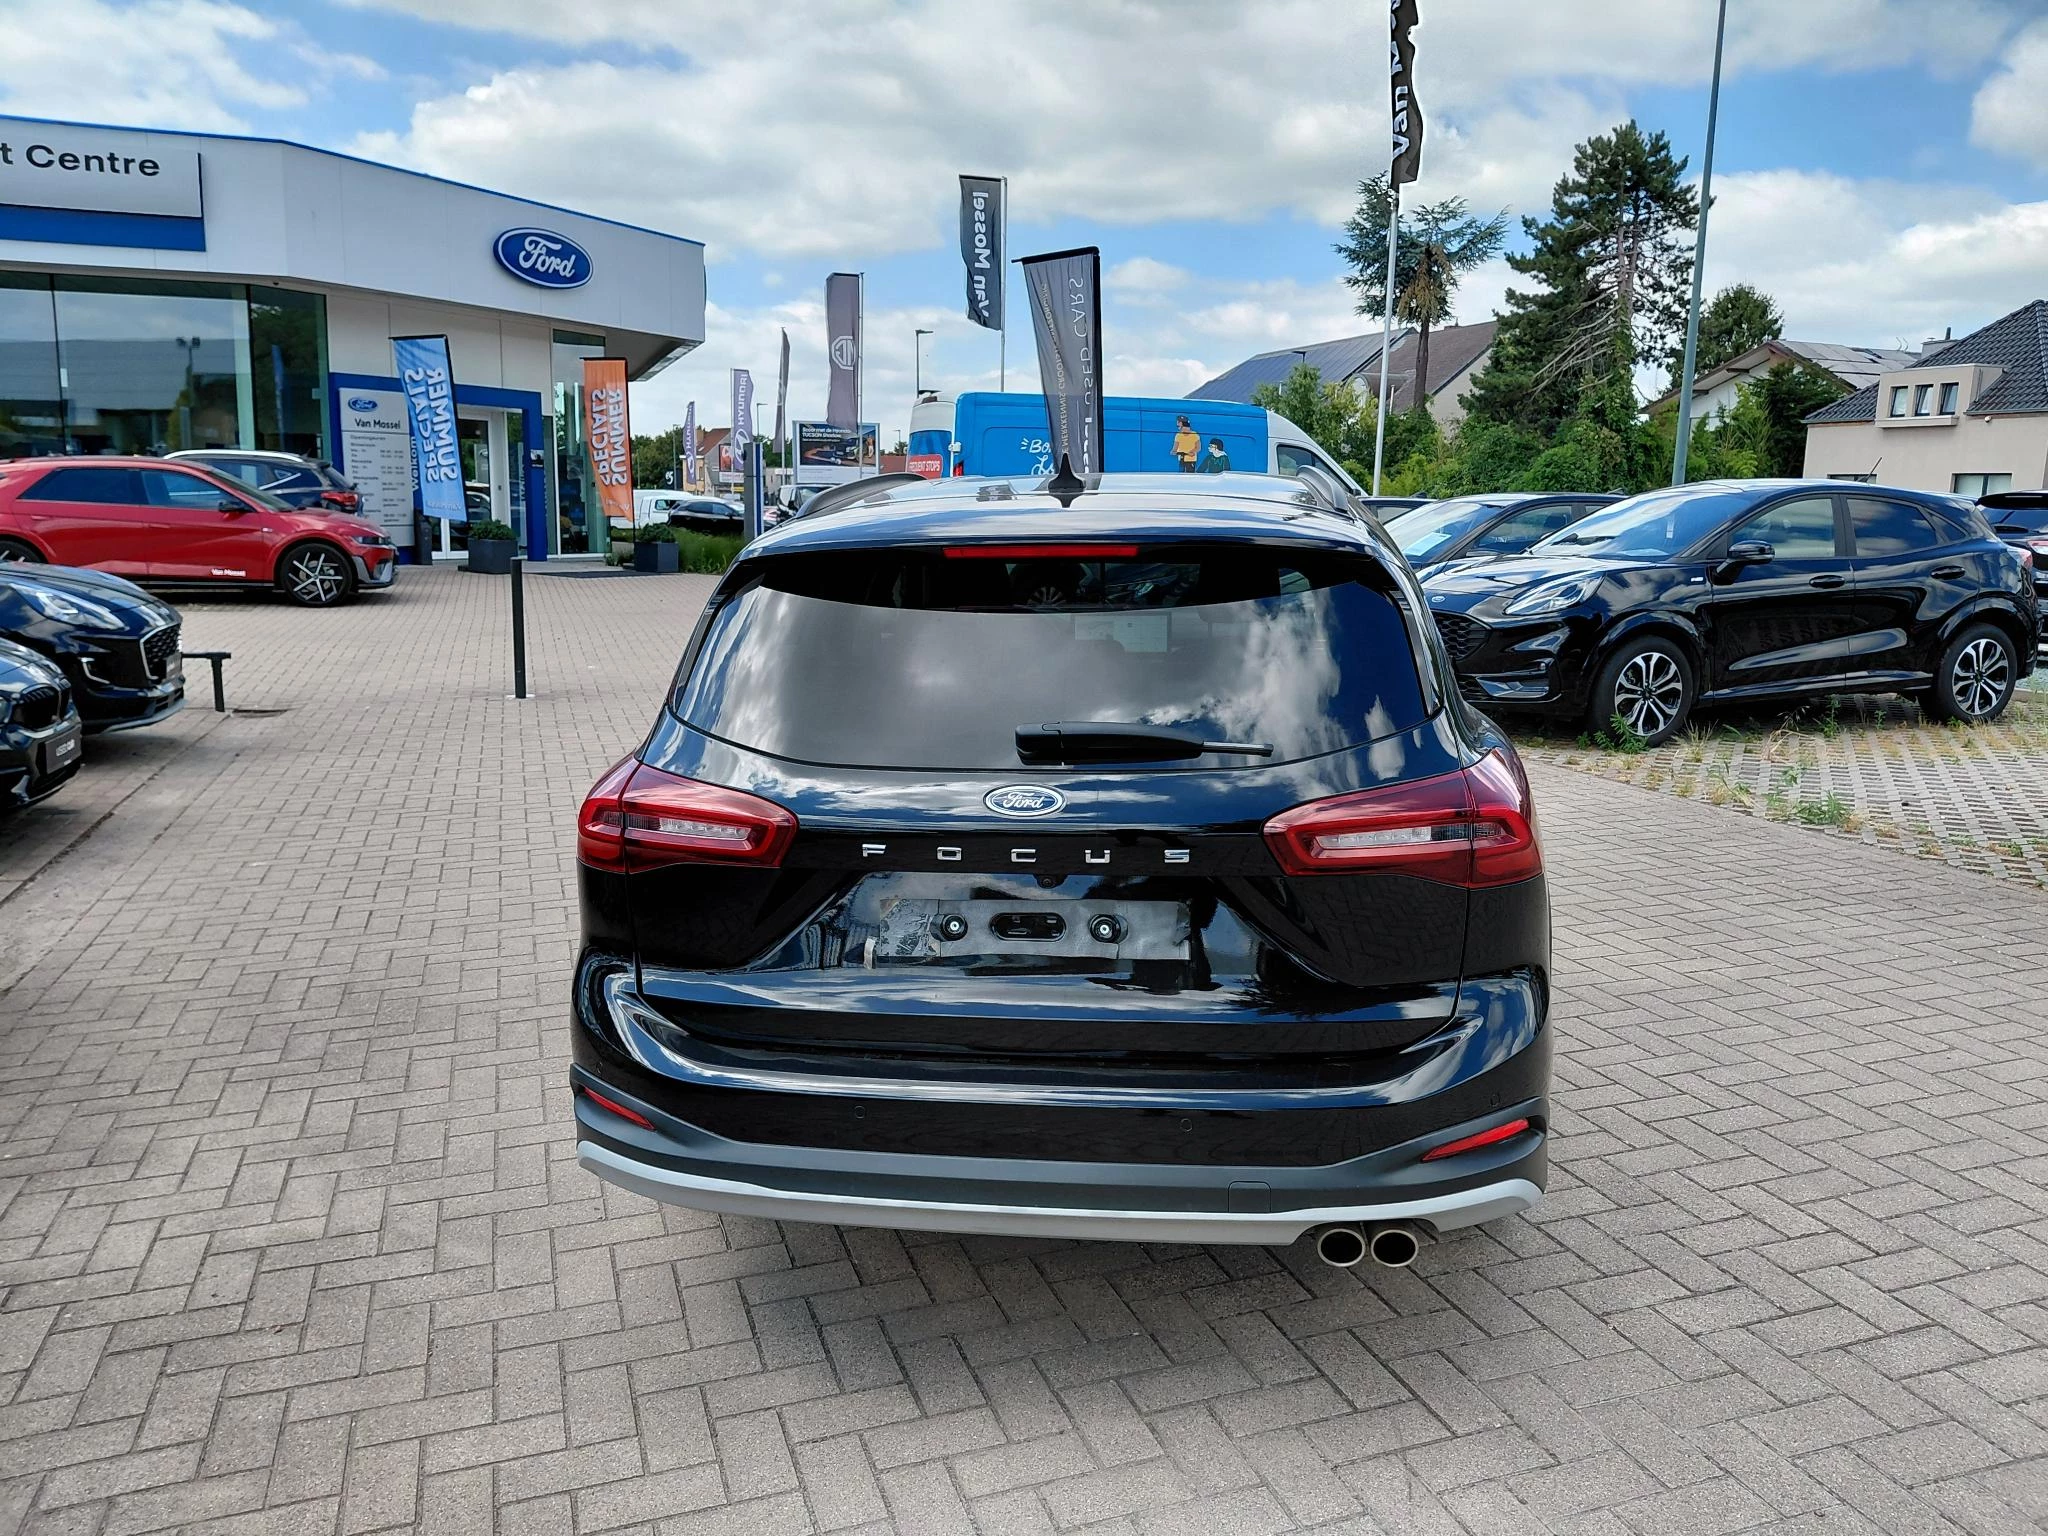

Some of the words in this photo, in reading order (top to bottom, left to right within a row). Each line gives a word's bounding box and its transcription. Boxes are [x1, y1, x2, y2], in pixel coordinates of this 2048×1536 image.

[1392, 85, 1410, 162] Van
[25, 144, 161, 177] Centre
[518, 235, 577, 278] Ford
[354, 418, 371, 427] Van
[373, 419, 401, 430] Mossel
[410, 436, 420, 492] Welkom
[926, 460, 940, 472] STOPS
[1002, 791, 1047, 810] Ford
[861, 842, 1191, 864] FOCUS
